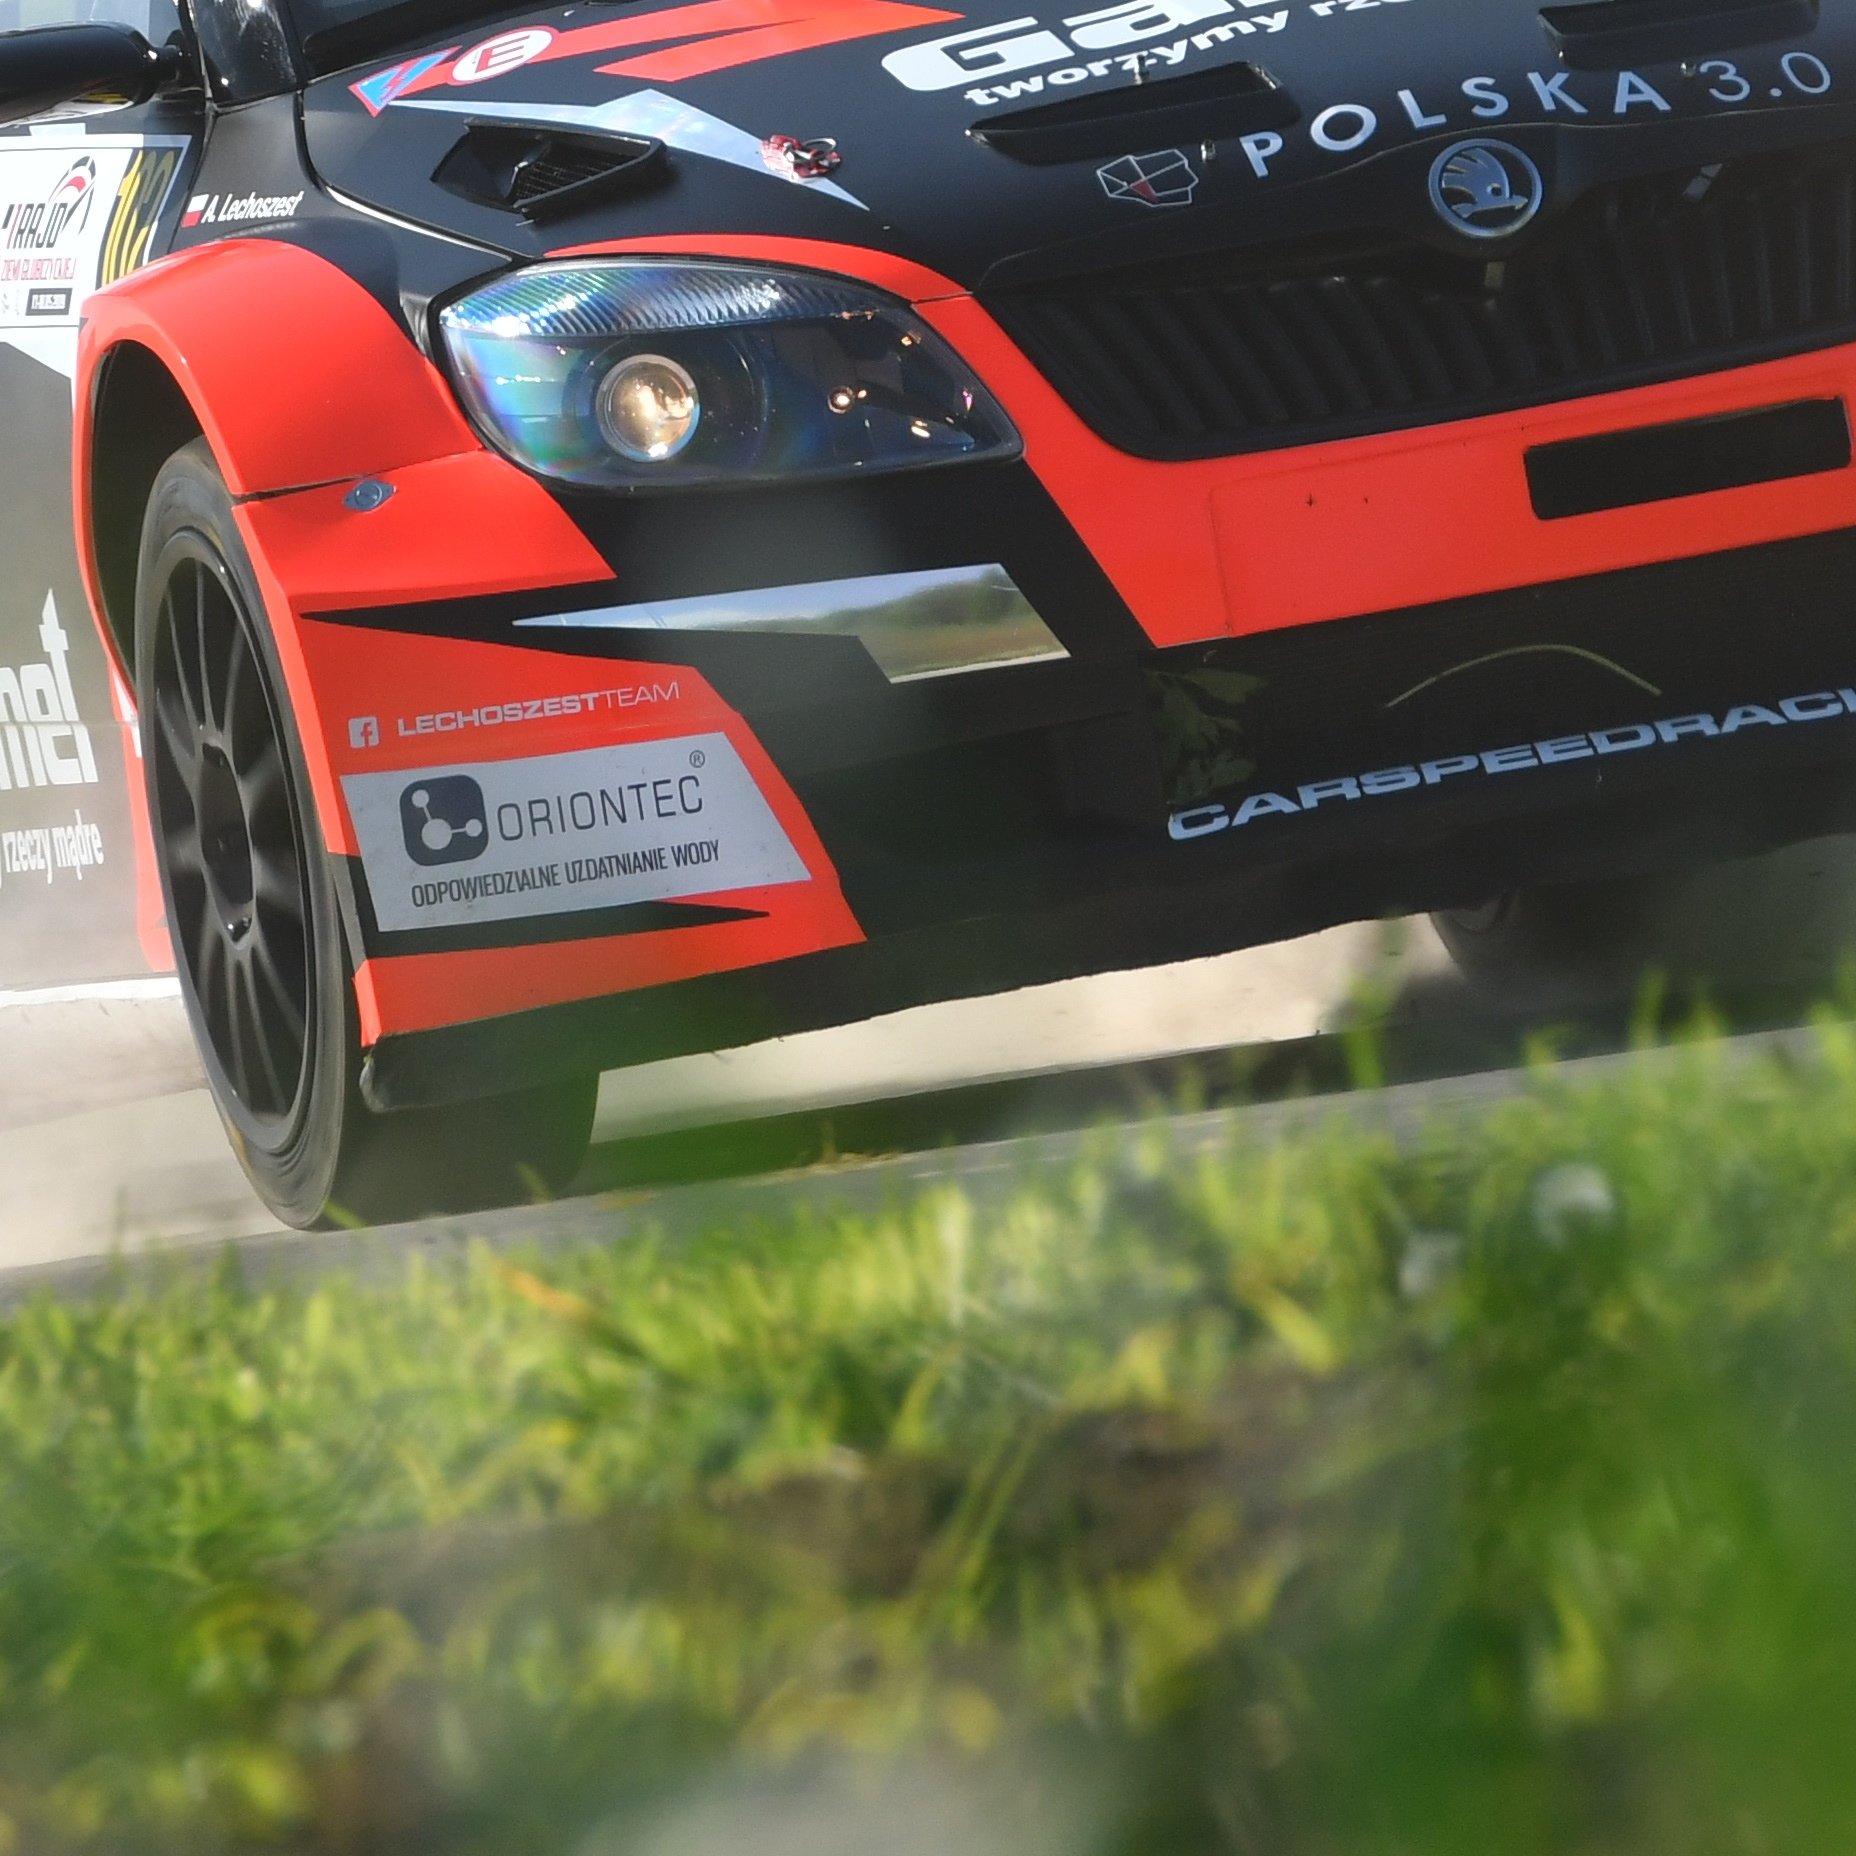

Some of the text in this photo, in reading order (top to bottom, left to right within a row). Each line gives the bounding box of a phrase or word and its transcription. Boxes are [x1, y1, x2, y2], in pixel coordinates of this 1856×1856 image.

[963, 7, 1292, 107] tworzymy
[1239, 50, 1834, 179] POLSKA 3.0
[12, 202, 69, 249] RAJD
[218, 189, 305, 223] Lechoszest
[496, 774, 705, 842] ORIONTEC
[2, 827, 54, 885] rzeczy
[410, 838, 721, 908] ODPOWIEDZIALNE UZDATNIANIE WODY
